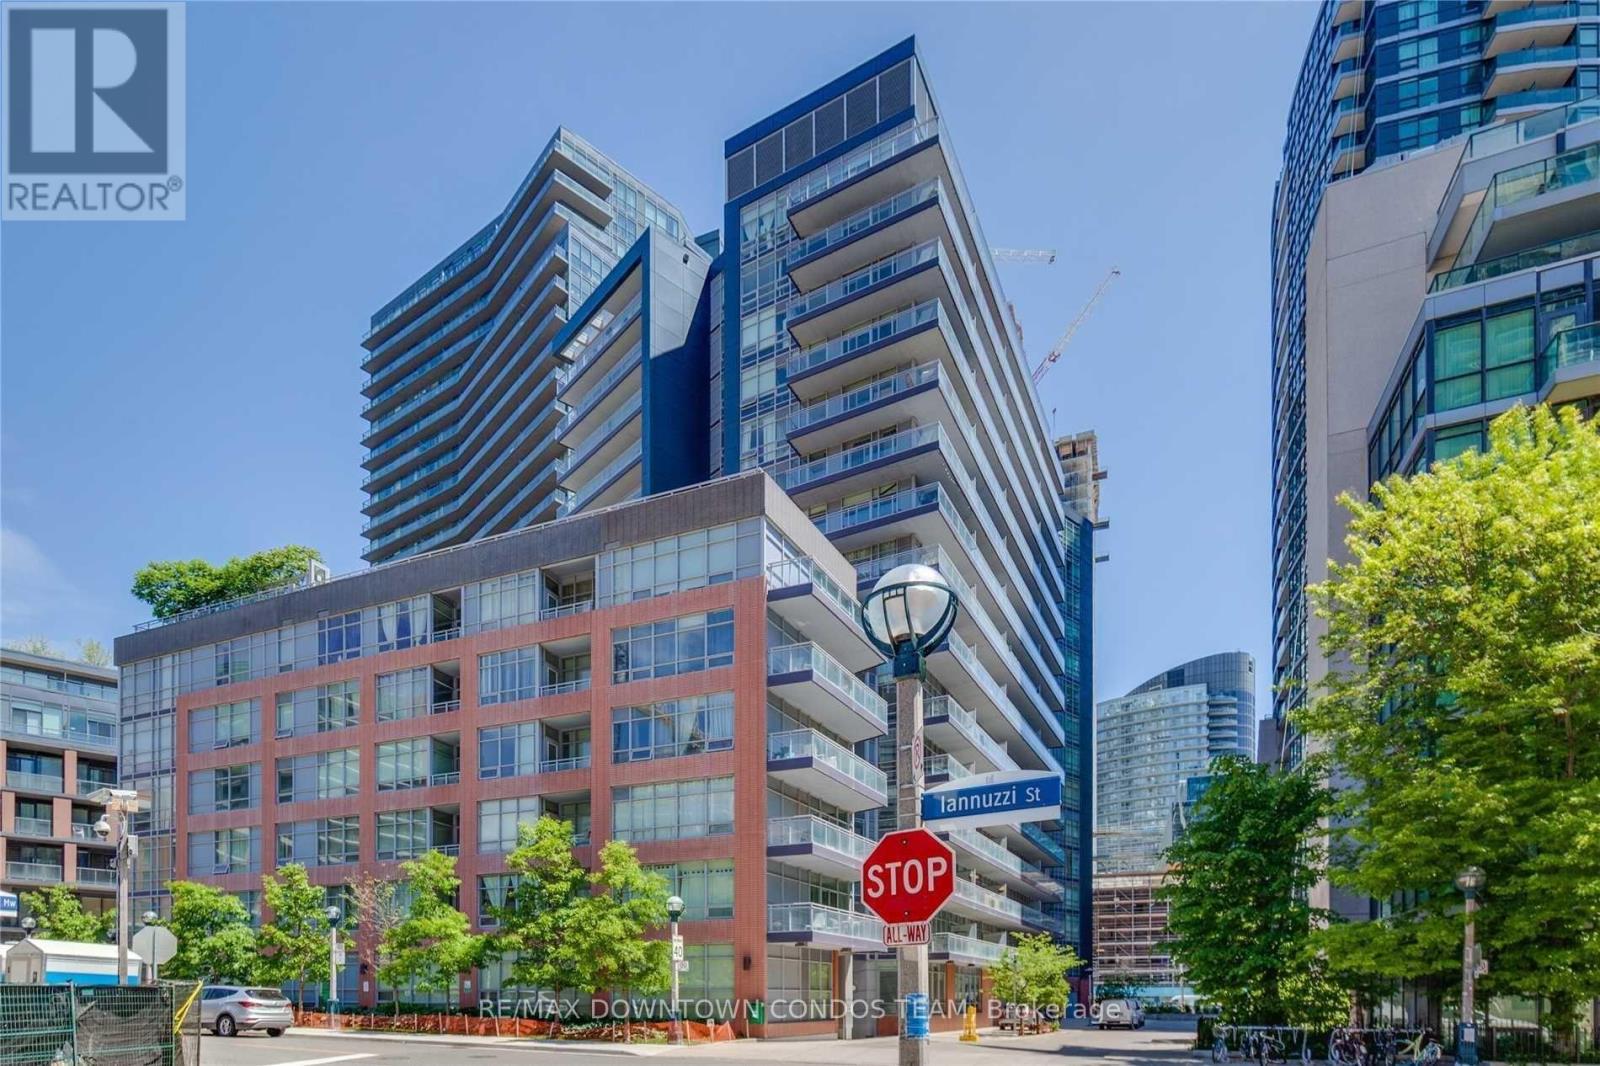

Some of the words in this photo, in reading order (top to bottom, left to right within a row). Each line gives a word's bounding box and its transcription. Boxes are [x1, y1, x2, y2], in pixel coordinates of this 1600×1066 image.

[940, 785, 1017, 813] Iannuzzi
[1025, 787, 1041, 803] St
[867, 856, 948, 898] STOP
[886, 924, 927, 943] ALL-WAY
